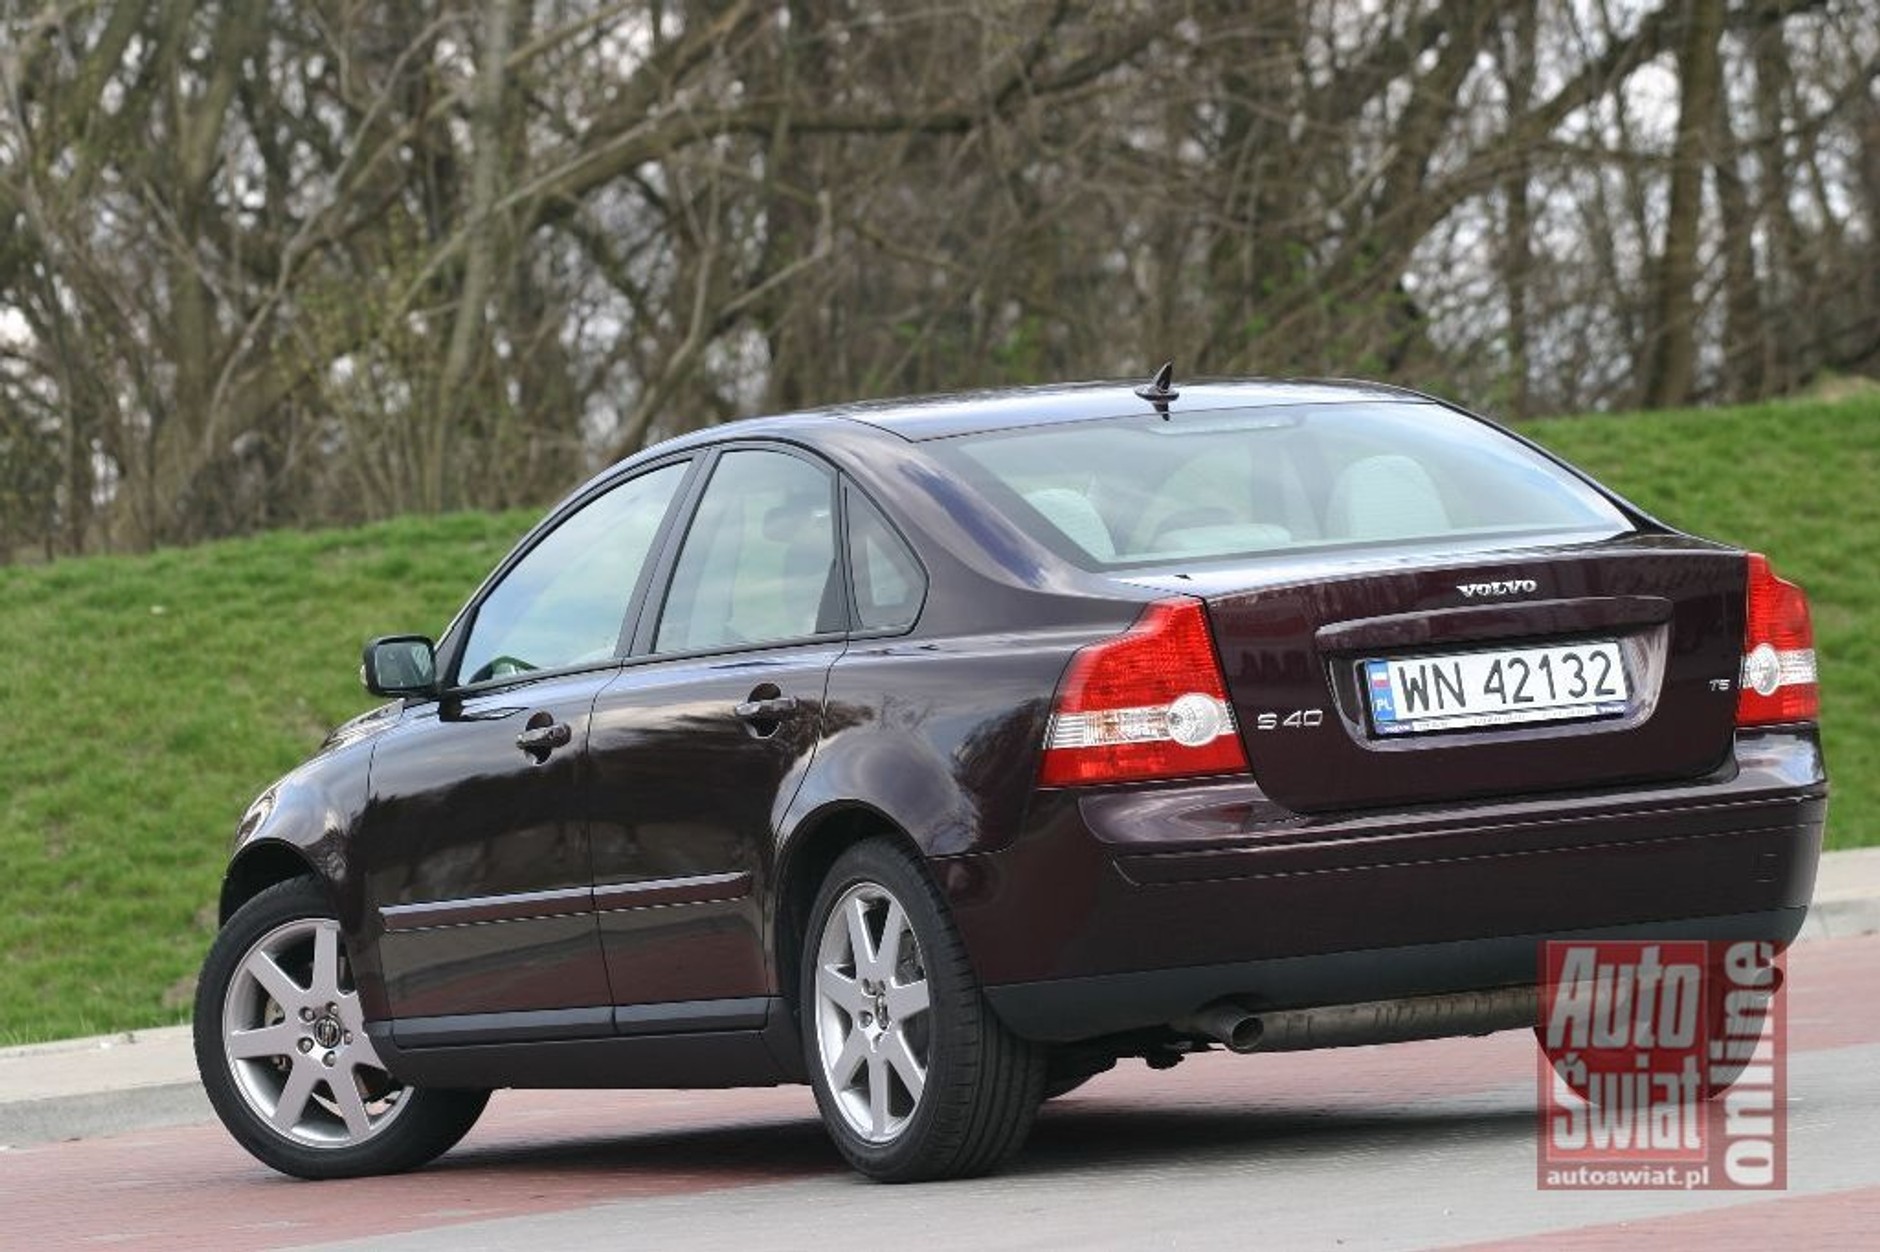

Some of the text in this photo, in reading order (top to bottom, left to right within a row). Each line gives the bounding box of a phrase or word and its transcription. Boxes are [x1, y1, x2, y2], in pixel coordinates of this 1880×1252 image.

[1456, 580, 1537, 597] VOLVO
[1398, 650, 1617, 713] WN 42132
[1376, 698, 1393, 711] PL
[1257, 709, 1323, 730] S 40
